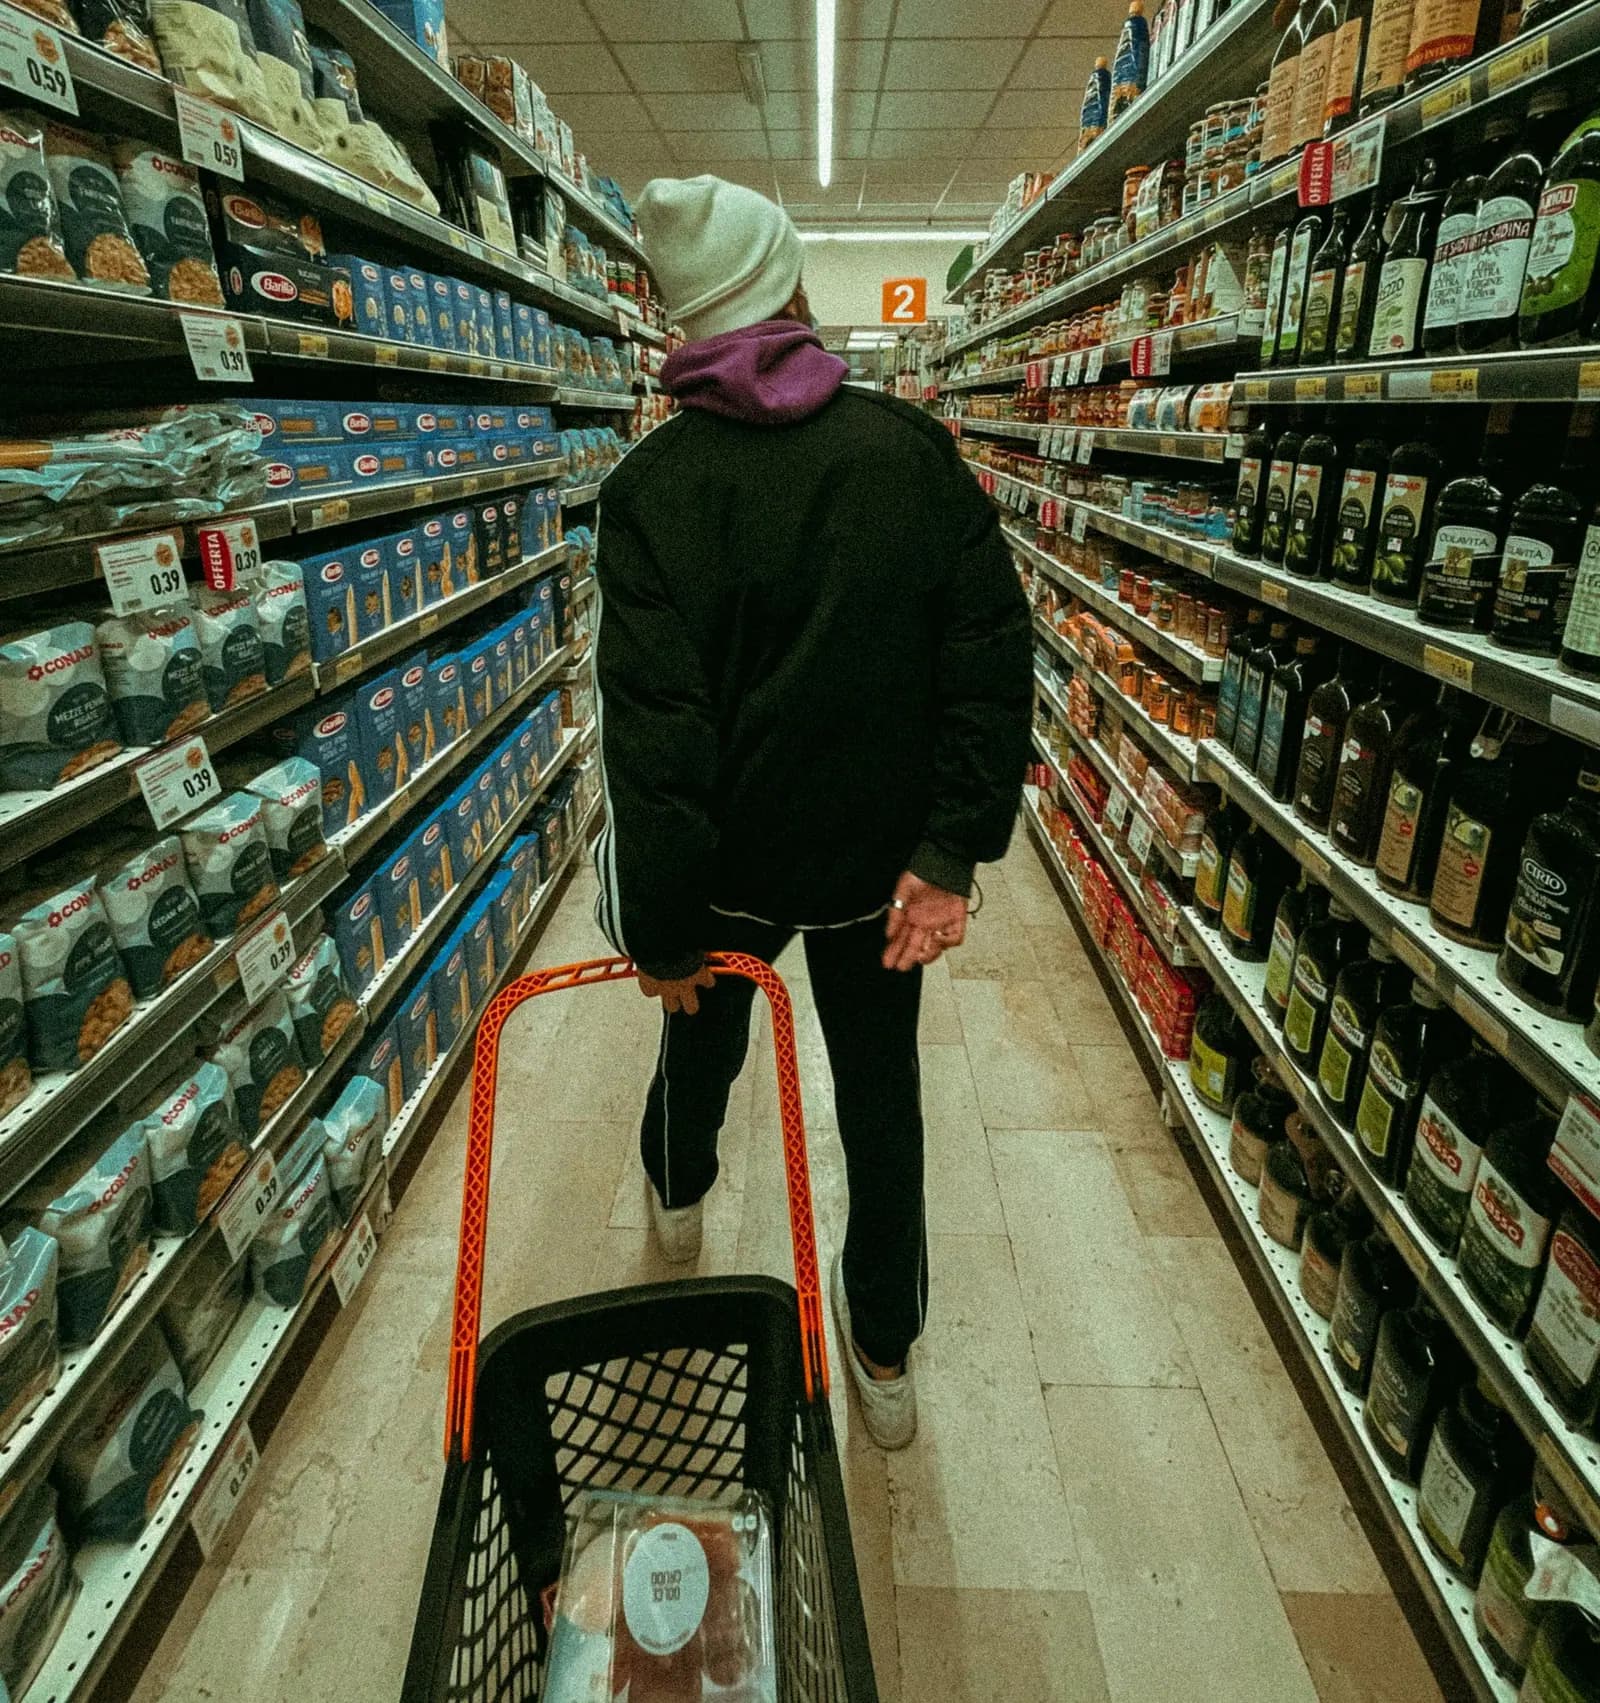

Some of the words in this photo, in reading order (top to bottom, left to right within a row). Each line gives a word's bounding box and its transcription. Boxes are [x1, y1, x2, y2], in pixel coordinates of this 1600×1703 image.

[1308, 145, 1326, 203] OFFERTA
[264, 278, 294, 295] Barilla
[893, 284, 915, 319] 2
[1136, 337, 1147, 374] OFFERTA
[1438, 532, 1490, 547] COLAVITA
[207, 532, 227, 589] OFFERTA
[44, 644, 94, 675] CONAD
[1525, 861, 1562, 891] CIRIO
